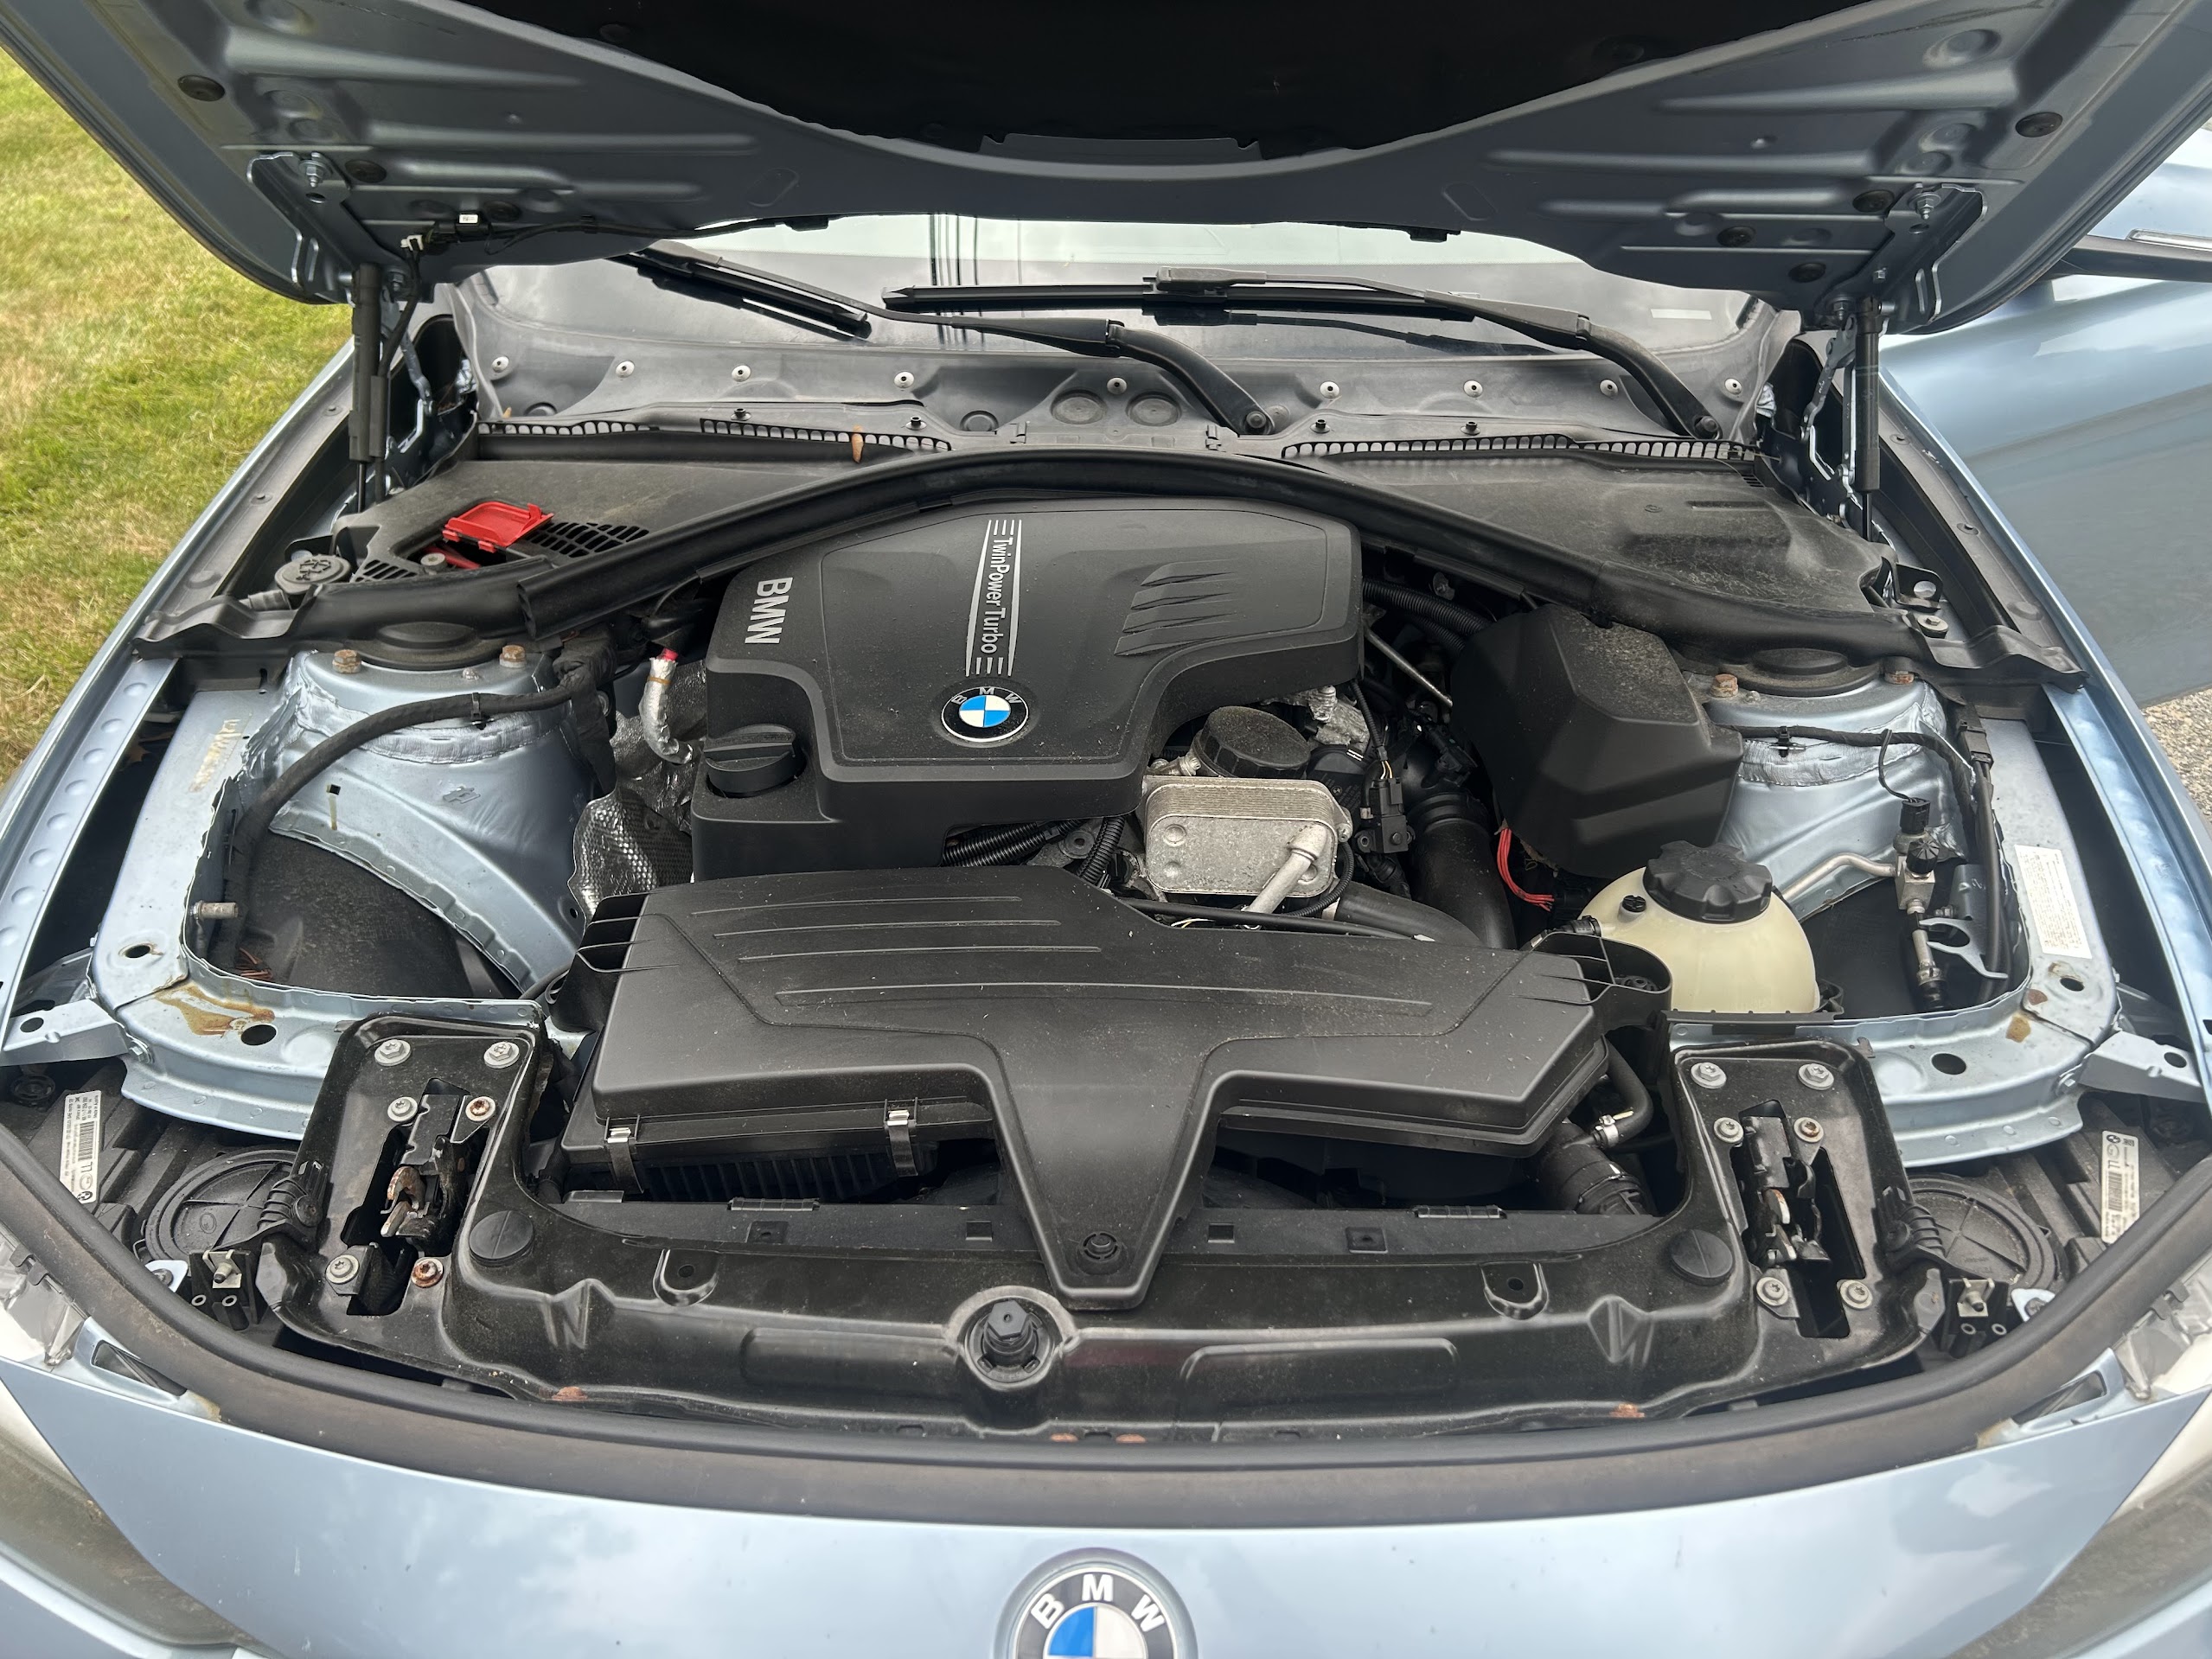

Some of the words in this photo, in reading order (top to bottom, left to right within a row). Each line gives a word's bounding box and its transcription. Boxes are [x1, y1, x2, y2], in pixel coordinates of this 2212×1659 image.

[986, 537, 1013, 607] TwinPower
[745, 577, 793, 644] BMW
[981, 607, 1006, 654] Turbo
[951, 687, 1022, 705] BMW
[1030, 1573, 1166, 1632] BMW
